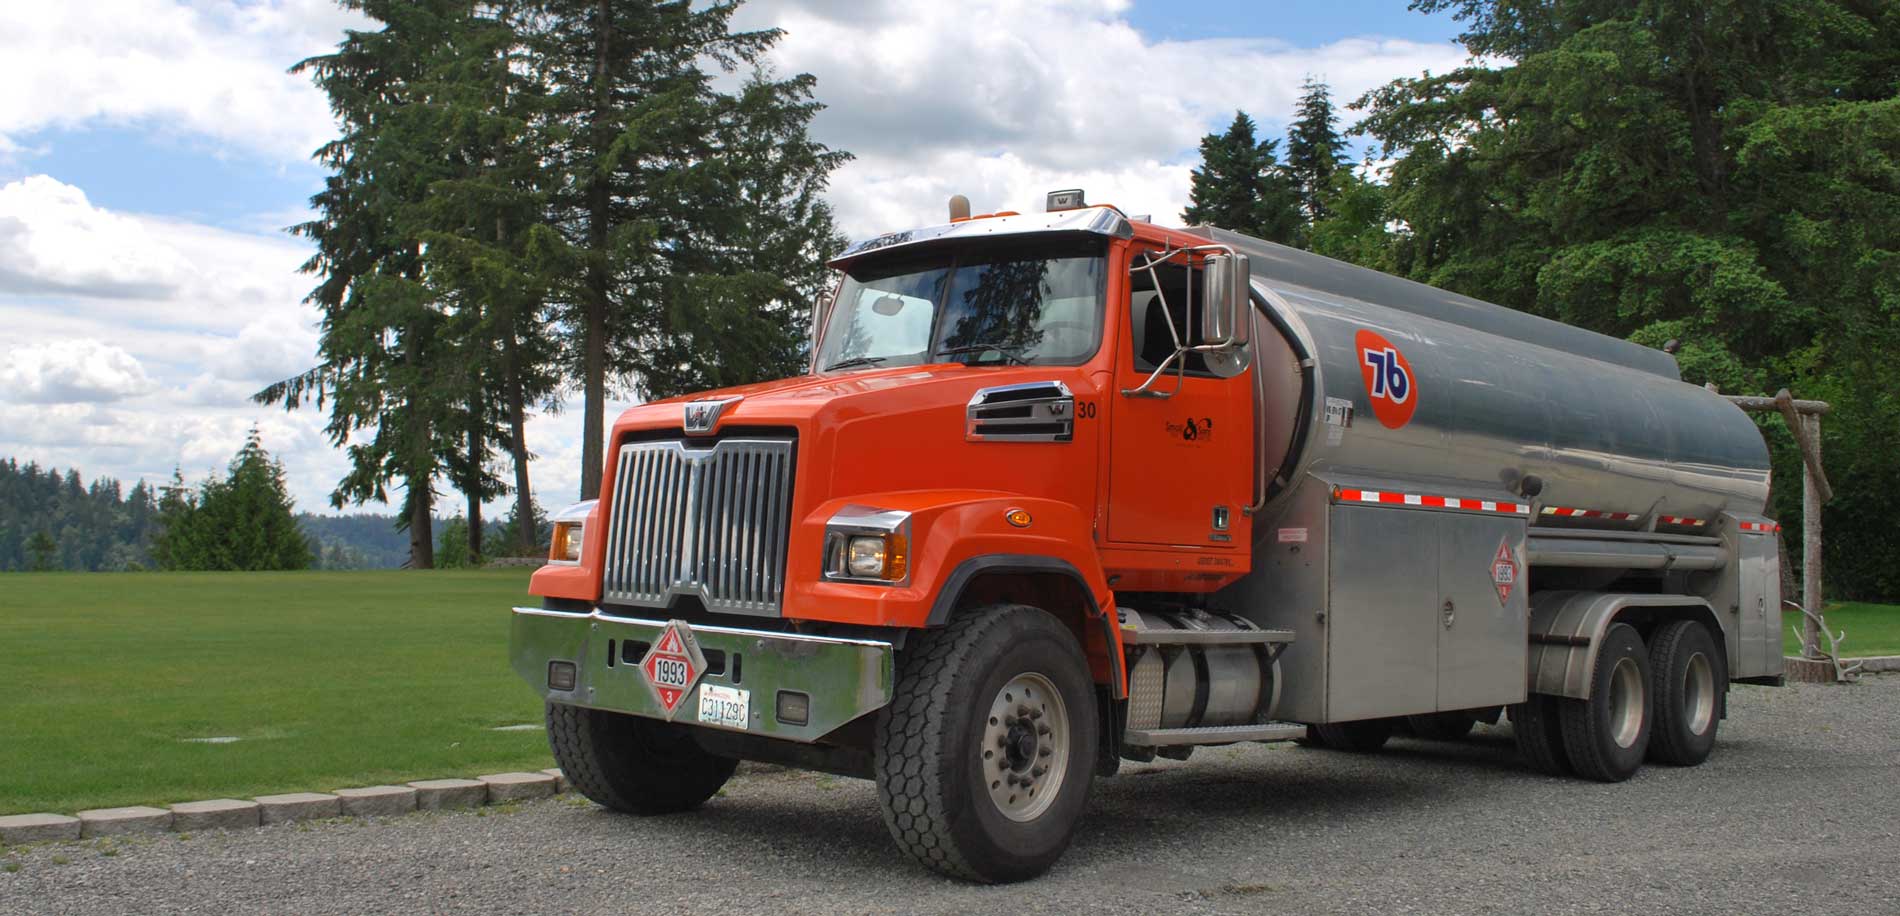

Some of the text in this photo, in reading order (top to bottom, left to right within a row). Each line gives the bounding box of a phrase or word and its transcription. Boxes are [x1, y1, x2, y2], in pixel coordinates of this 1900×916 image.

[1363, 347, 1410, 404] 76
[1078, 401, 1096, 419] 30
[656, 659, 686, 686] 1993
[666, 690, 673, 703] 3
[701, 697, 746, 722] C31129C
